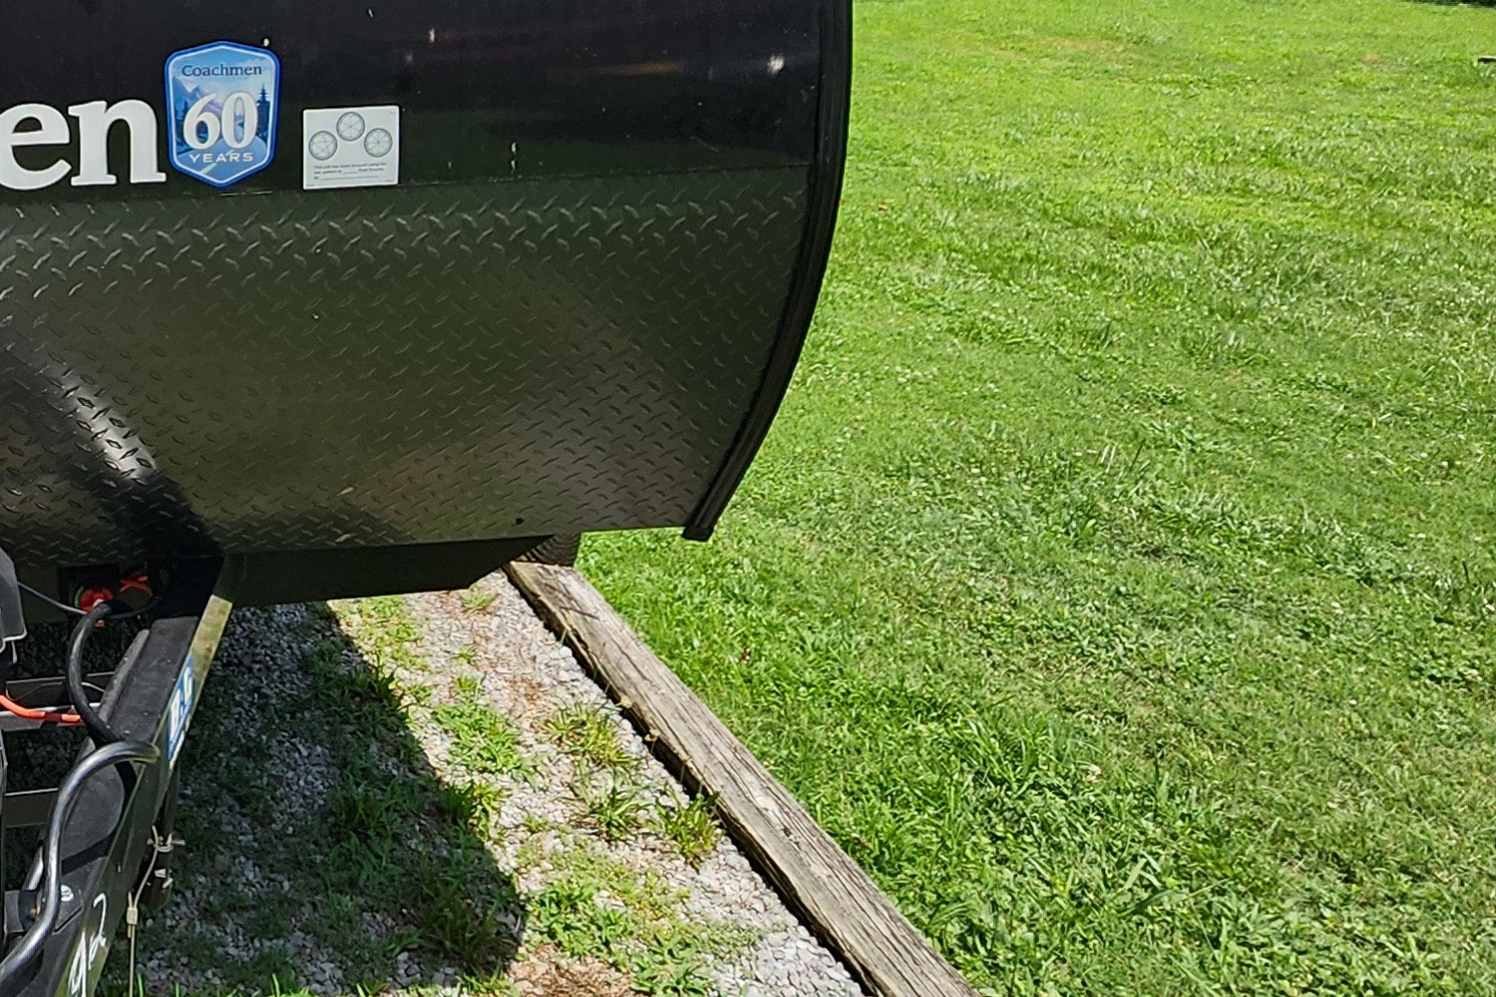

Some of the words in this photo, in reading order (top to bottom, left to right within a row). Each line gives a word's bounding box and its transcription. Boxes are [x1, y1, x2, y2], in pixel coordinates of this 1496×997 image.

[182, 64, 262, 78] Coachmen
[183, 91, 258, 150] 60
[189, 152, 254, 164] YEARS
